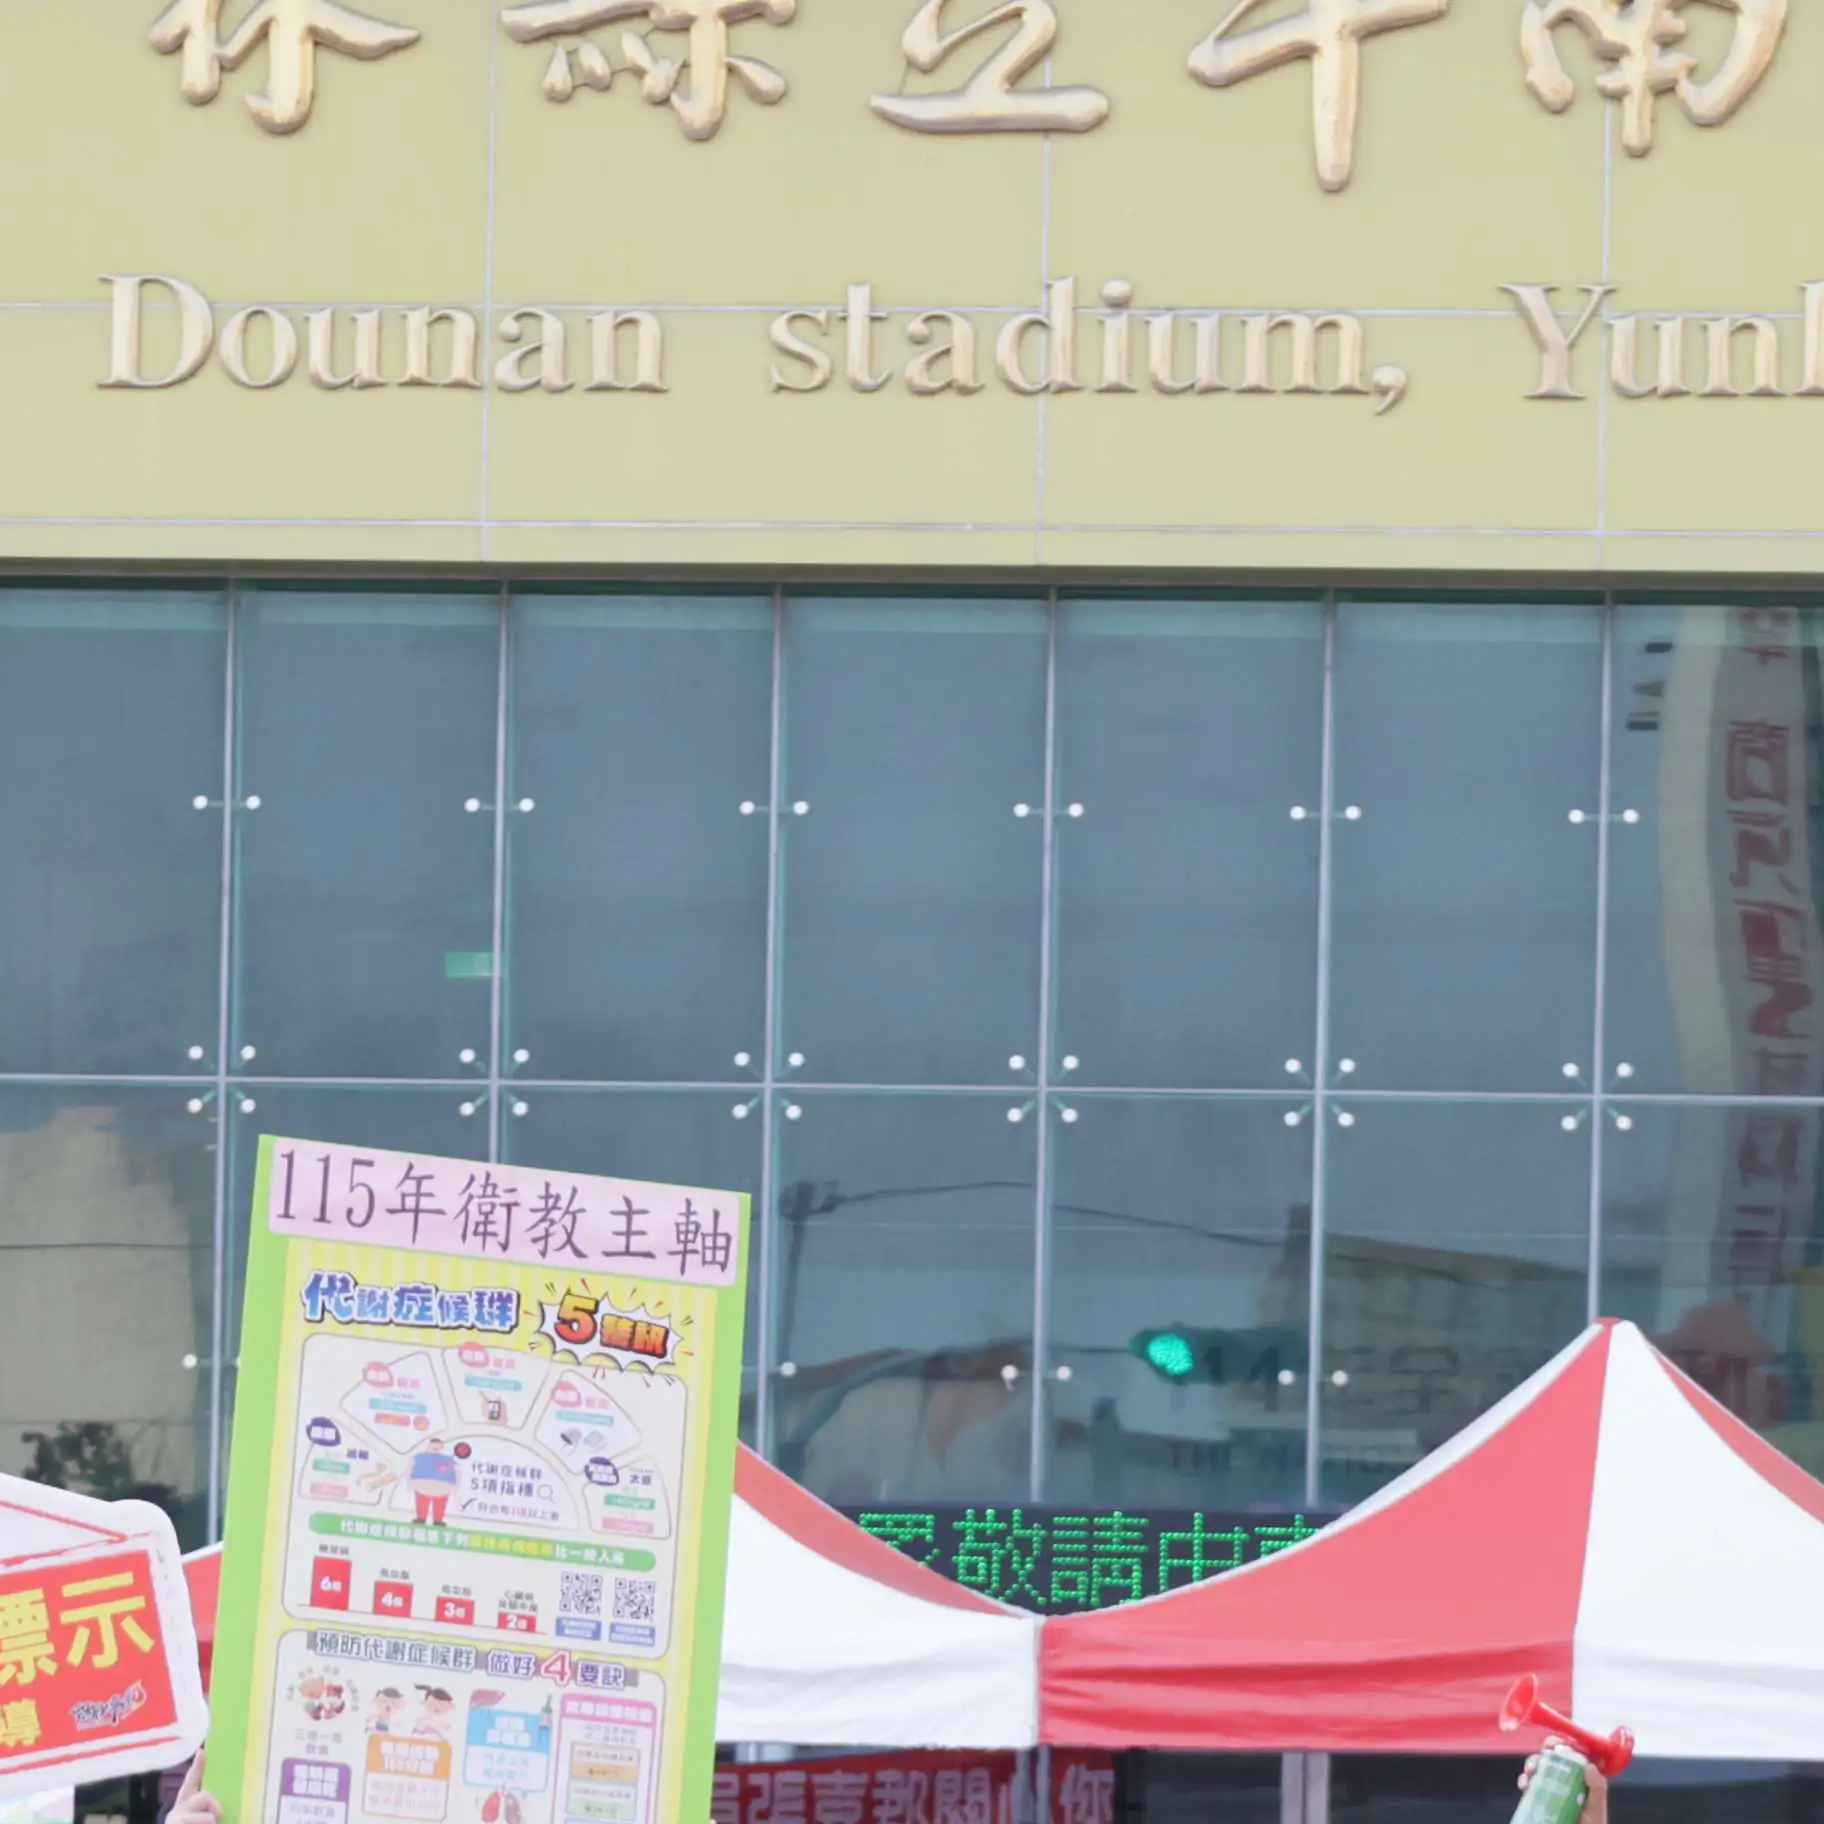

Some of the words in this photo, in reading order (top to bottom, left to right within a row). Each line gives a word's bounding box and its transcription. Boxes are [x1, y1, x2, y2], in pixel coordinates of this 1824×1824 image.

[97, 272, 668, 394] Dounan
[770, 277, 1409, 412] stadium,
[277, 1148, 732, 1276] 115年衛教主軸
